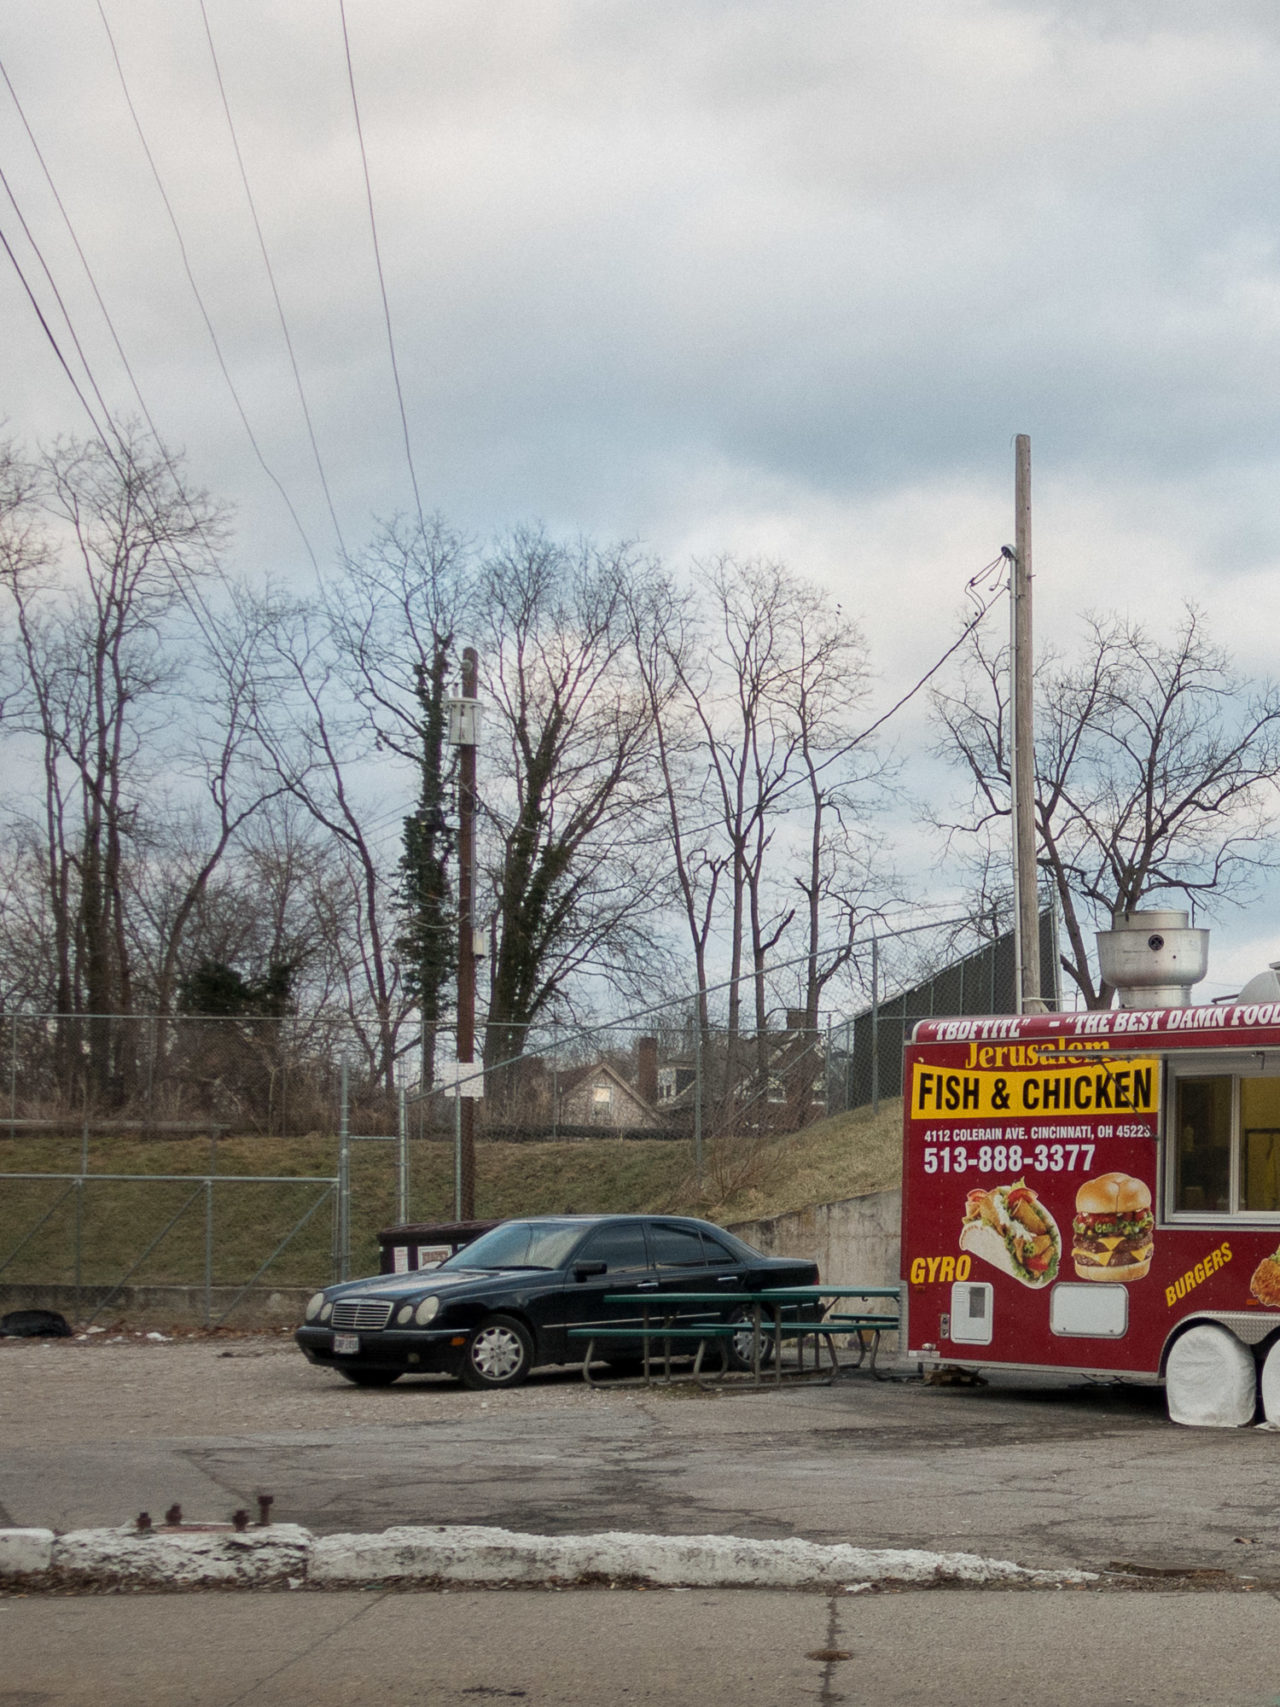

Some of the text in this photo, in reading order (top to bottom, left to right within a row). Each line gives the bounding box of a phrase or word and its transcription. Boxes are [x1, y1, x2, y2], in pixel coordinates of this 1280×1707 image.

[1065, 1013, 1112, 1034] "THE
[1113, 1009, 1164, 1032] BEST
[1166, 1006, 1232, 1029] DAMN
[918, 1067, 1152, 1110] FISH & CHICKEN
[924, 1124, 1151, 1142] 4112 COLERAIN AVE. CINCINNATI, OH 45223
[924, 1144, 1096, 1174] 513-888-3377
[910, 1254, 972, 1284] GYRO
[1164, 1242, 1233, 1307] BURGERS
